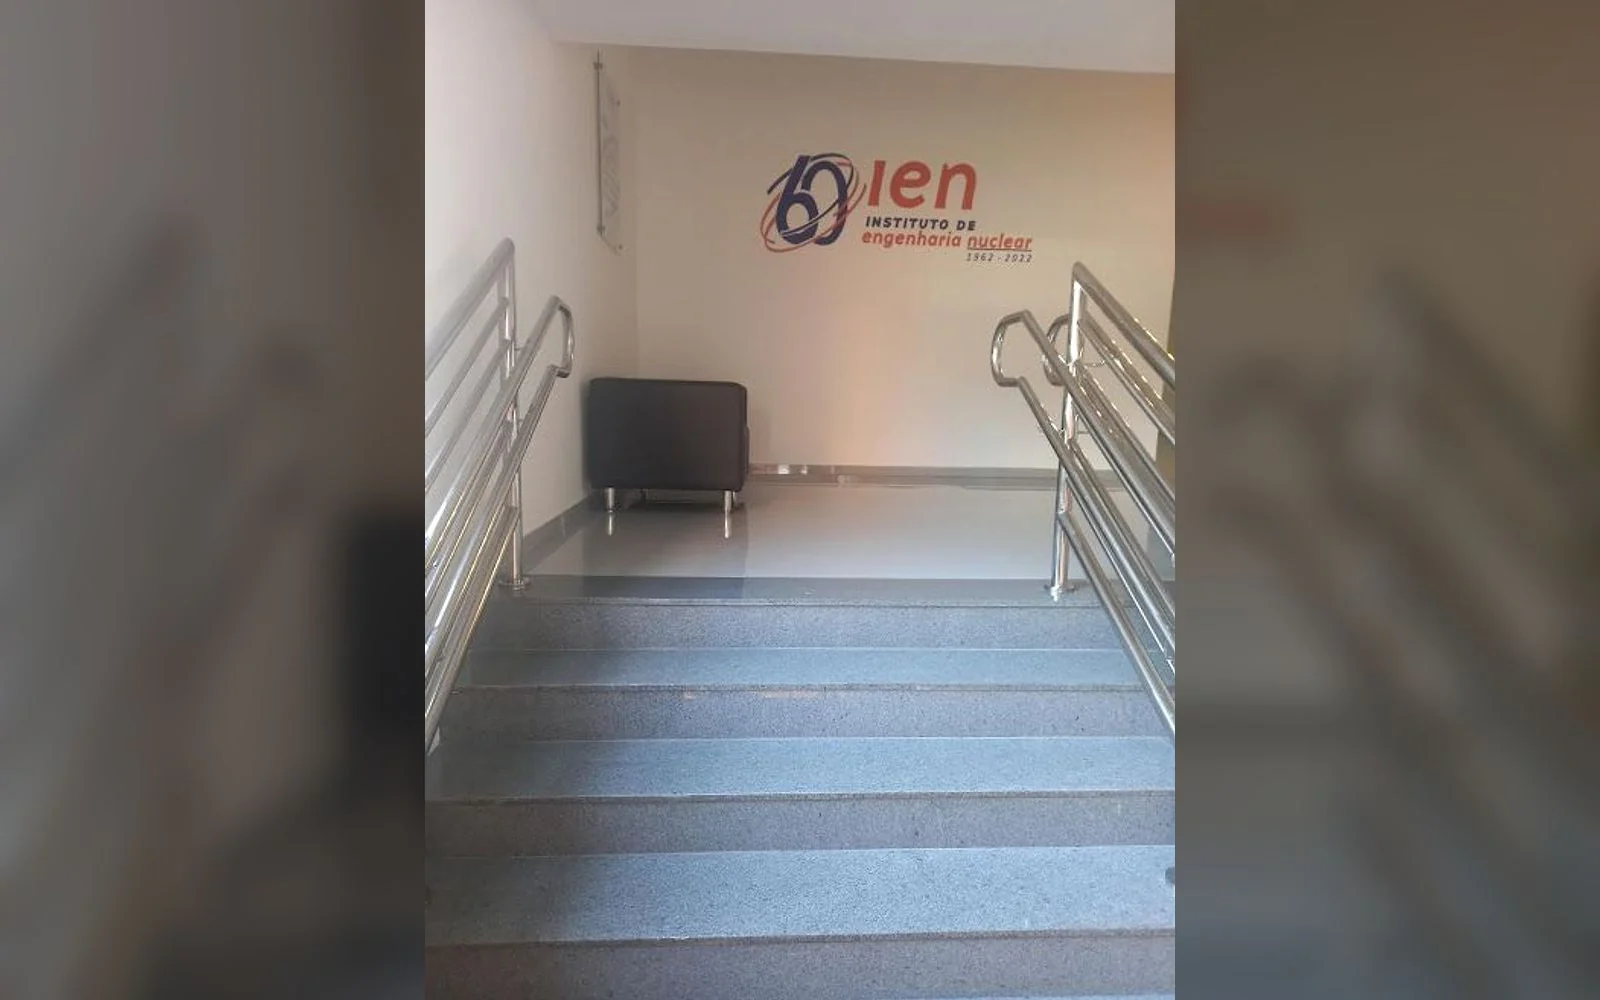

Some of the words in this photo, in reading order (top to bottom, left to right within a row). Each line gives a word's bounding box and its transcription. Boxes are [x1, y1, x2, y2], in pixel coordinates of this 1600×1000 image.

[865, 215, 949, 231] INSTITUTO
[956, 219, 977, 232] DE
[861, 230, 962, 249] engenharia
[967, 232, 1033, 250] nuclear
[966, 252, 994, 263] 1962
[1004, 253, 1033, 264] 2022
